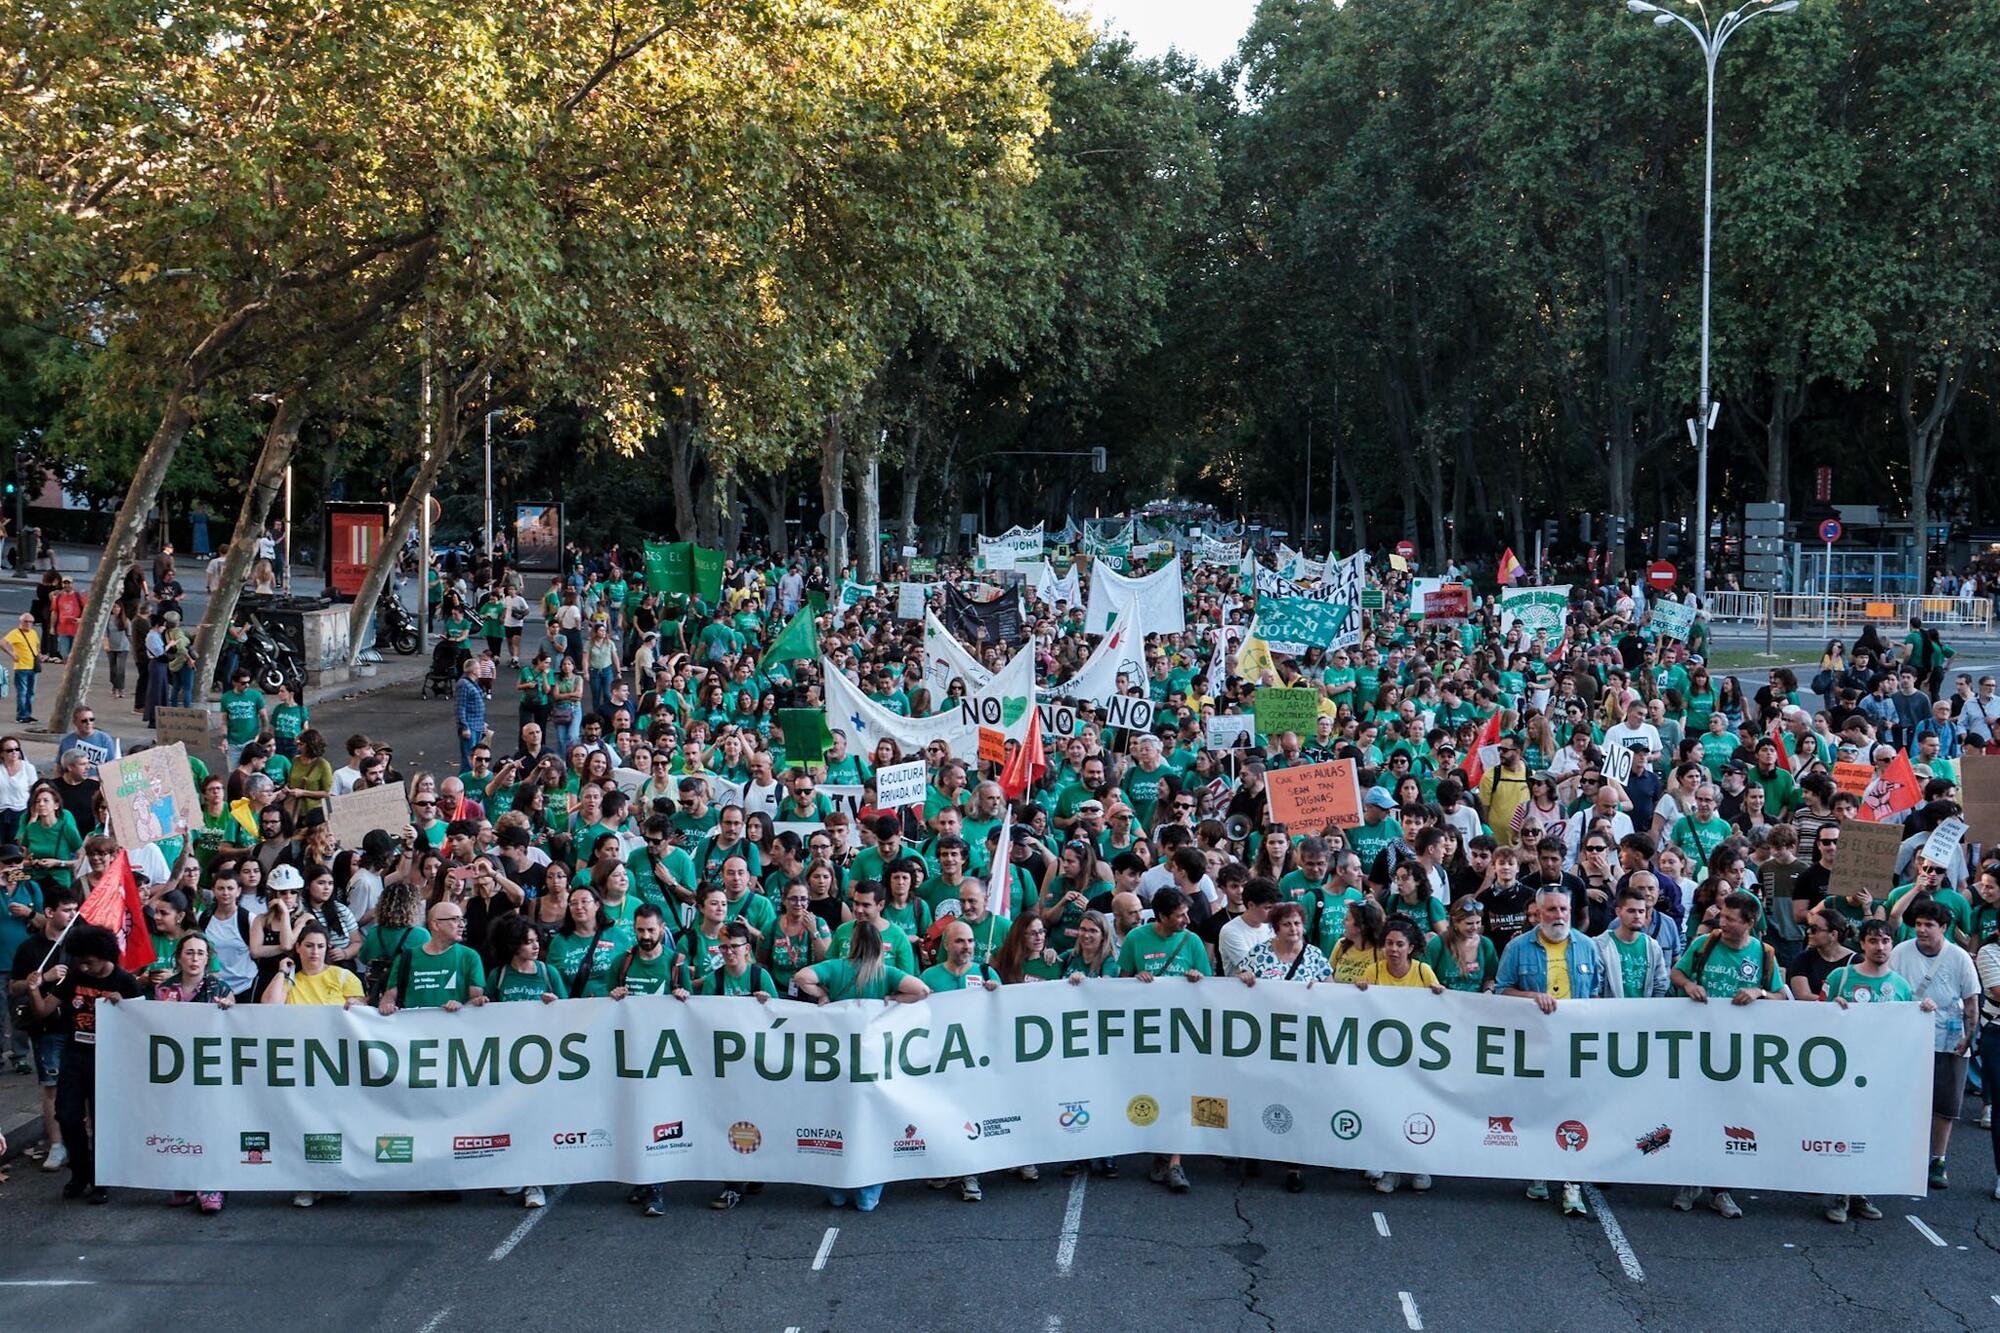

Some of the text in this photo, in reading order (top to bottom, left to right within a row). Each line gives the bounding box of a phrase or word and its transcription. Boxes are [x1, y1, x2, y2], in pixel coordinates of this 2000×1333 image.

[1105, 558, 1121, 568] NO
[961, 697, 1001, 725] NO
[1109, 695, 1151, 729] NO
[1038, 705, 1074, 735] NO
[1603, 744, 1631, 782] NO
[1314, 765, 1346, 779] AULAS
[1288, 785, 1309, 796] SEAN
[1295, 792, 1334, 806] DIGNAS
[1301, 806, 1326, 815] COMO
[148, 1007, 1868, 1089] DEFENDEMOS LA PÚBLICA. DEFENDEMOS EL FUTURO.
[1066, 1104, 1083, 1113] TEA
[657, 1126, 680, 1137] CNT
[796, 1128, 843, 1140] CONFAPA
[455, 1138, 493, 1149] CCOO
[553, 1132, 587, 1145] CGT
[669, 1141, 693, 1149] Sindical
[1725, 1141, 1757, 1152] STEM
[1802, 1140, 1832, 1152] UGT
